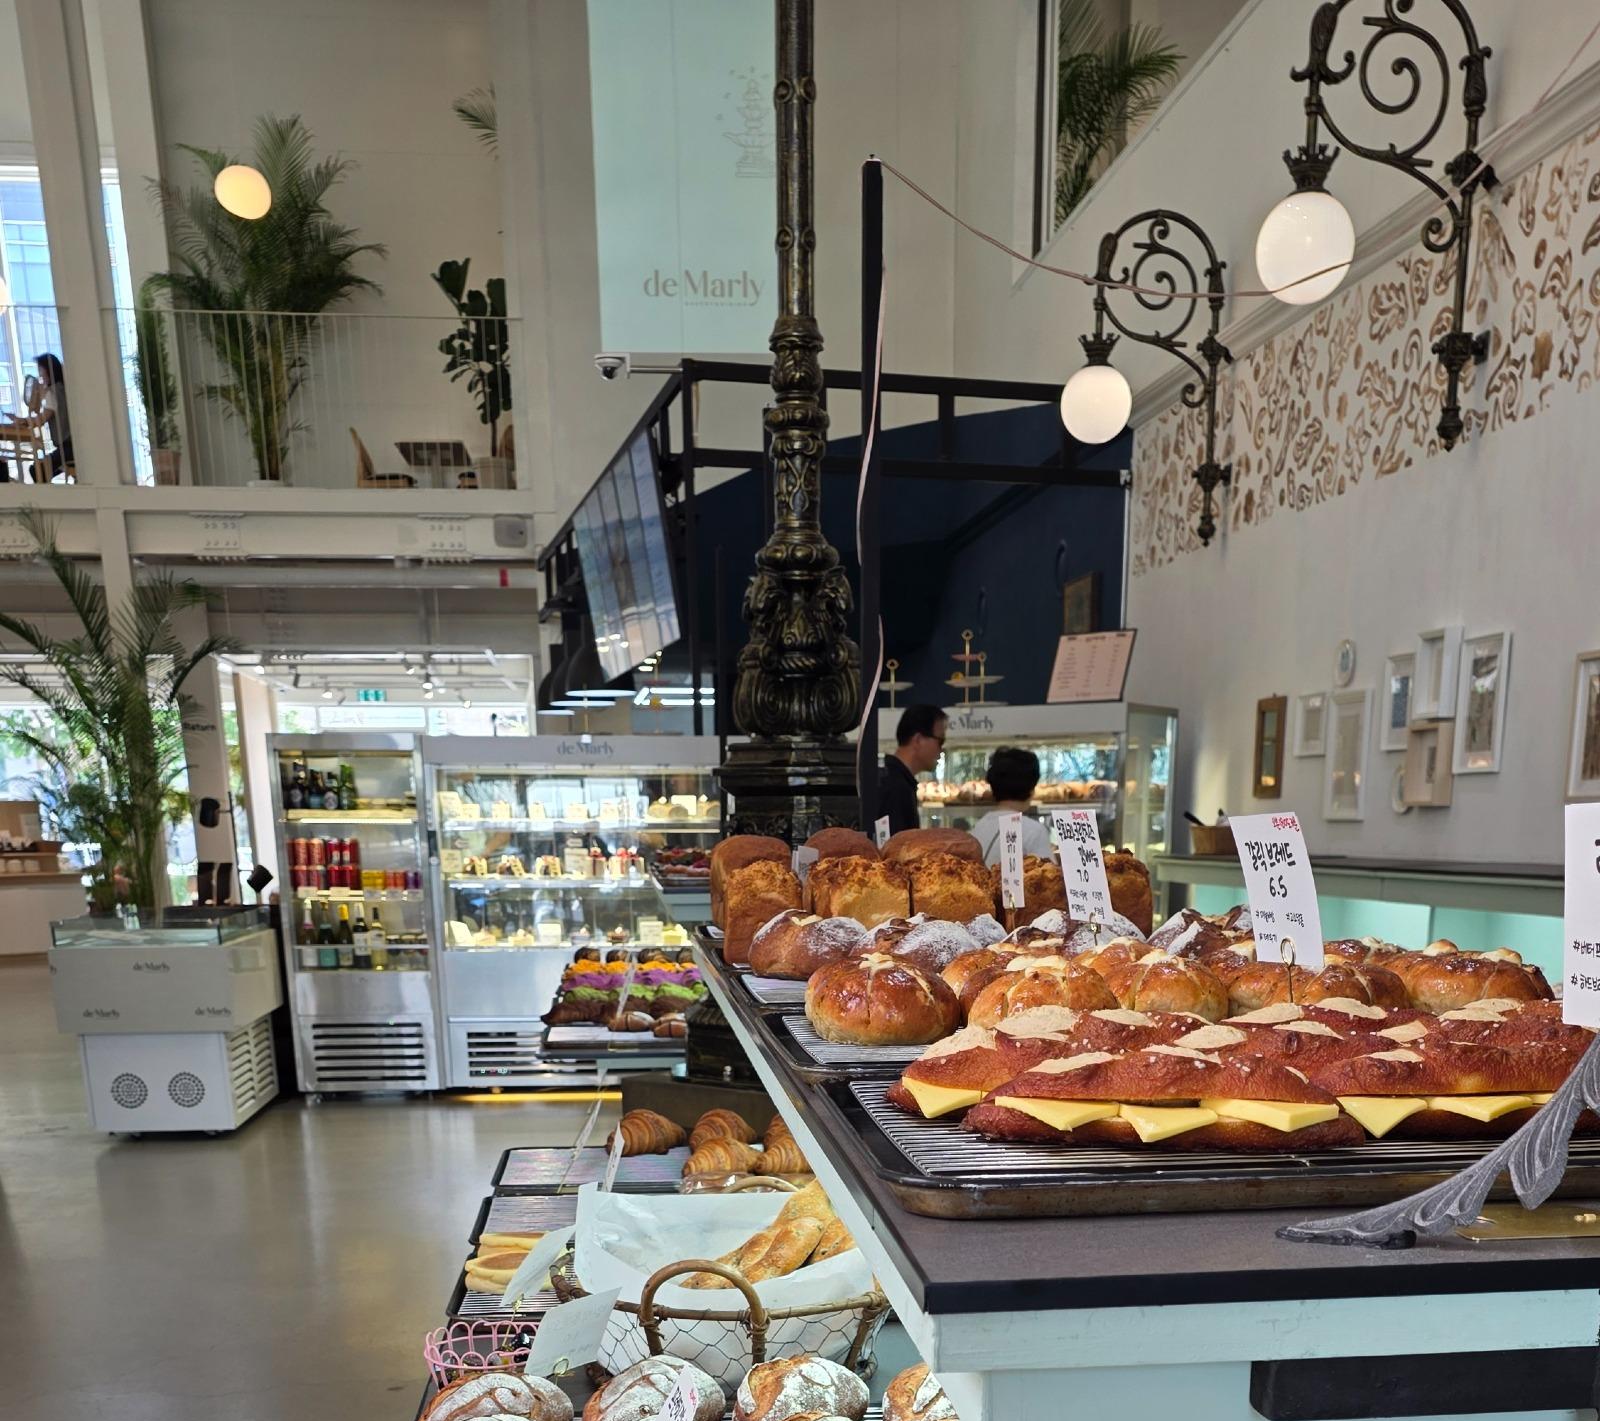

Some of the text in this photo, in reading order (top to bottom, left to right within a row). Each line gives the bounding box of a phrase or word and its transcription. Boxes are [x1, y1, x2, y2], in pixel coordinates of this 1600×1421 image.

[643, 269, 764, 306] de Marly
[958, 715, 994, 733] Marly
[556, 740, 615, 759] de Marly
[1245, 840, 1267, 872] 갈릭
[1269, 875, 1288, 898] 6.5
